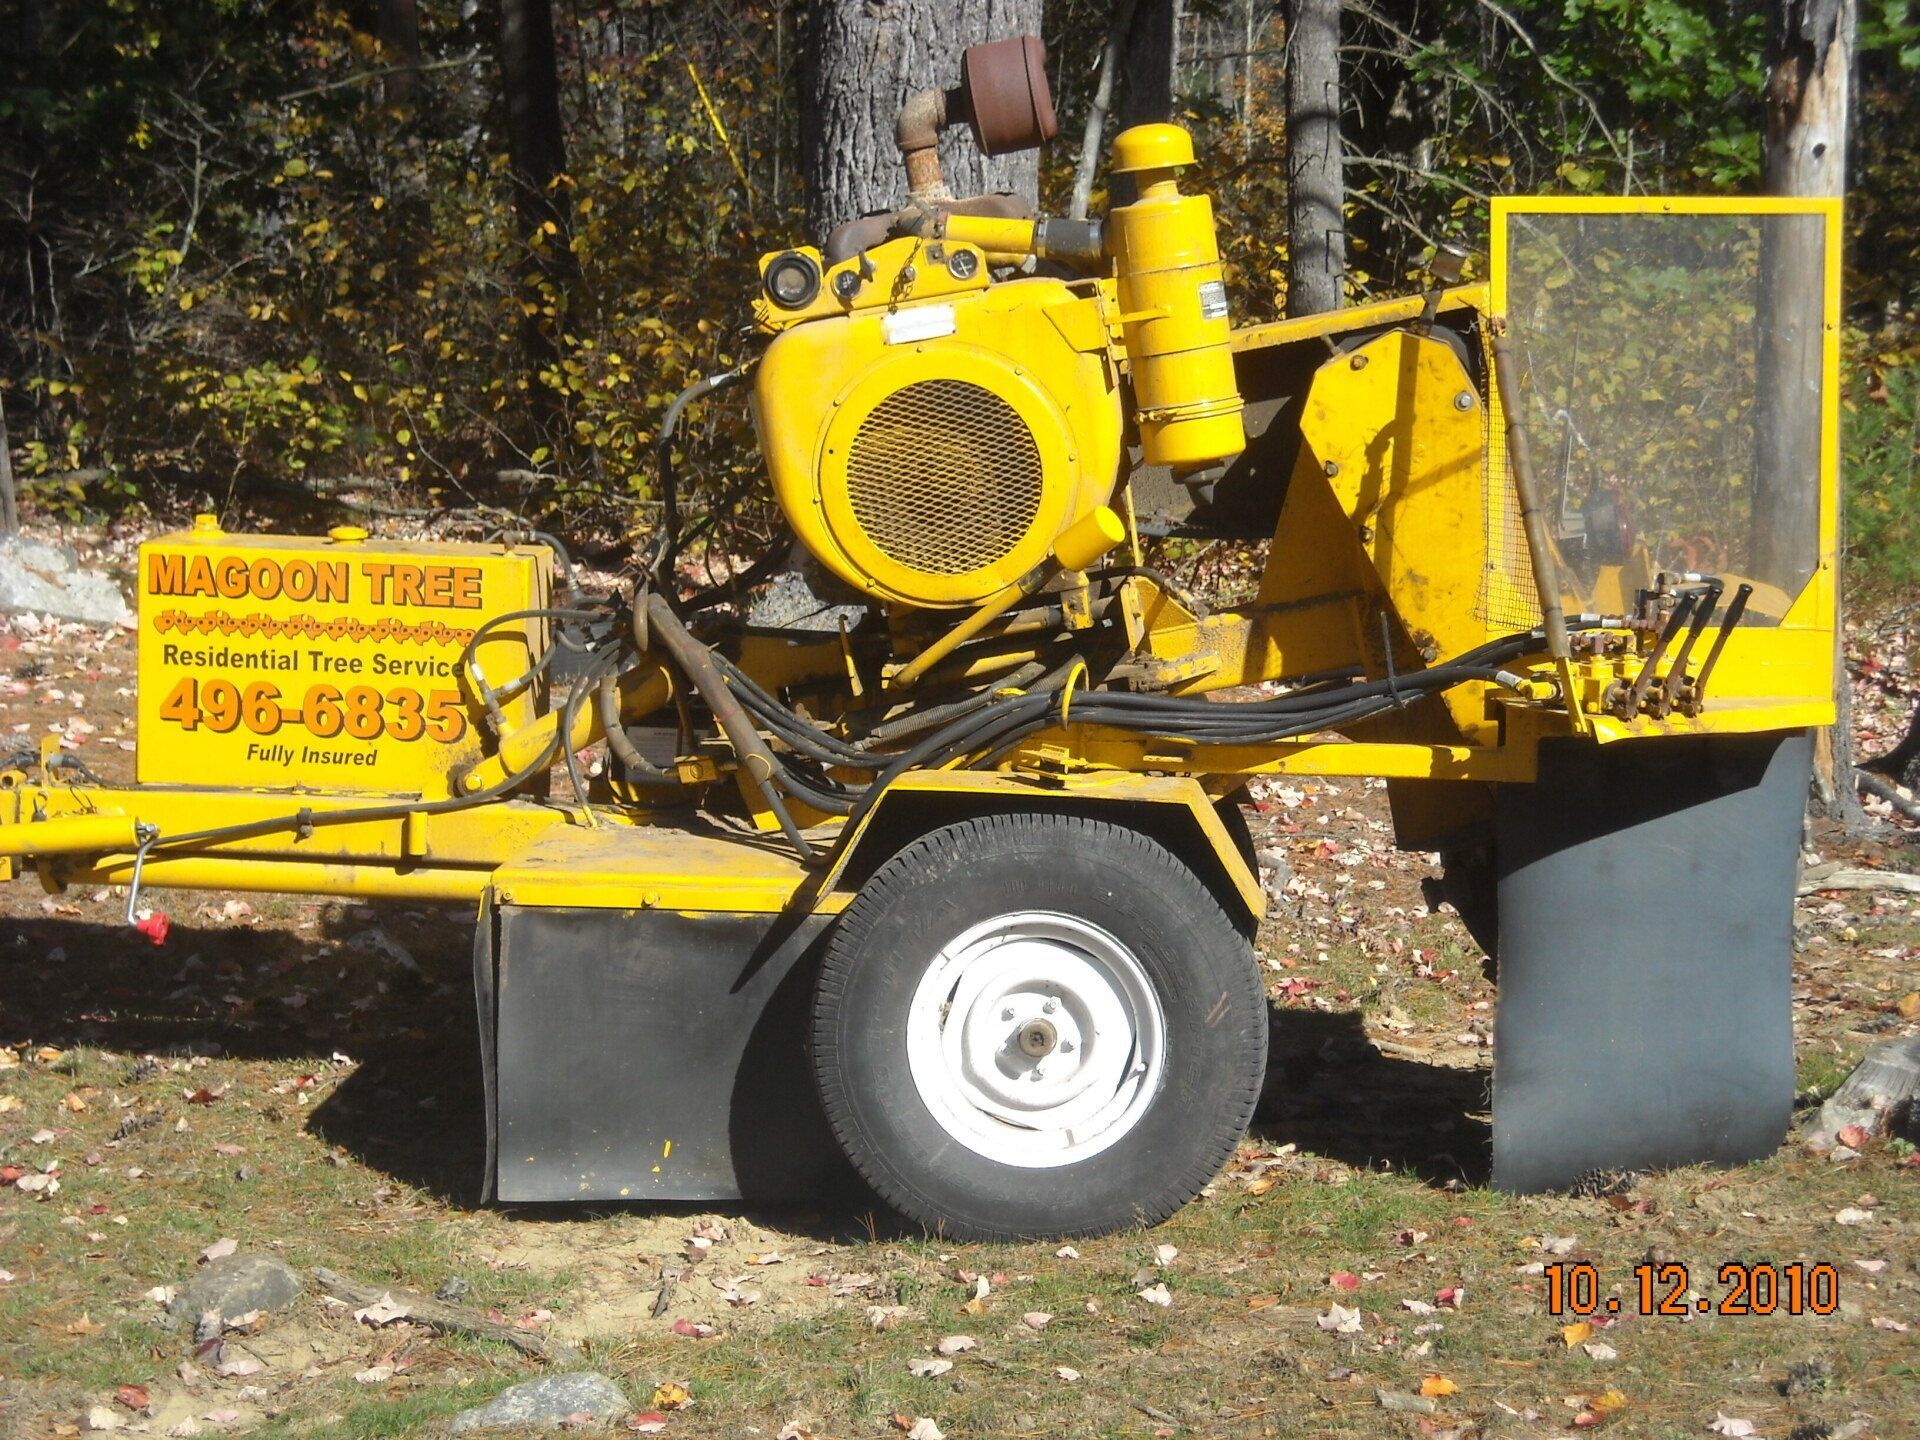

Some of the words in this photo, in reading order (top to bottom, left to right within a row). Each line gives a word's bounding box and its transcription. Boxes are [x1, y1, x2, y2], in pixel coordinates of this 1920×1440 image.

[148, 553, 349, 603] MAGOON
[362, 562, 482, 609] TREE
[163, 644, 298, 671] Residential
[308, 650, 363, 674] Tree
[372, 654, 464, 678] Service
[159, 676, 468, 744] 496-6835
[247, 743, 294, 767] Fully
[301, 746, 378, 767] Insured
